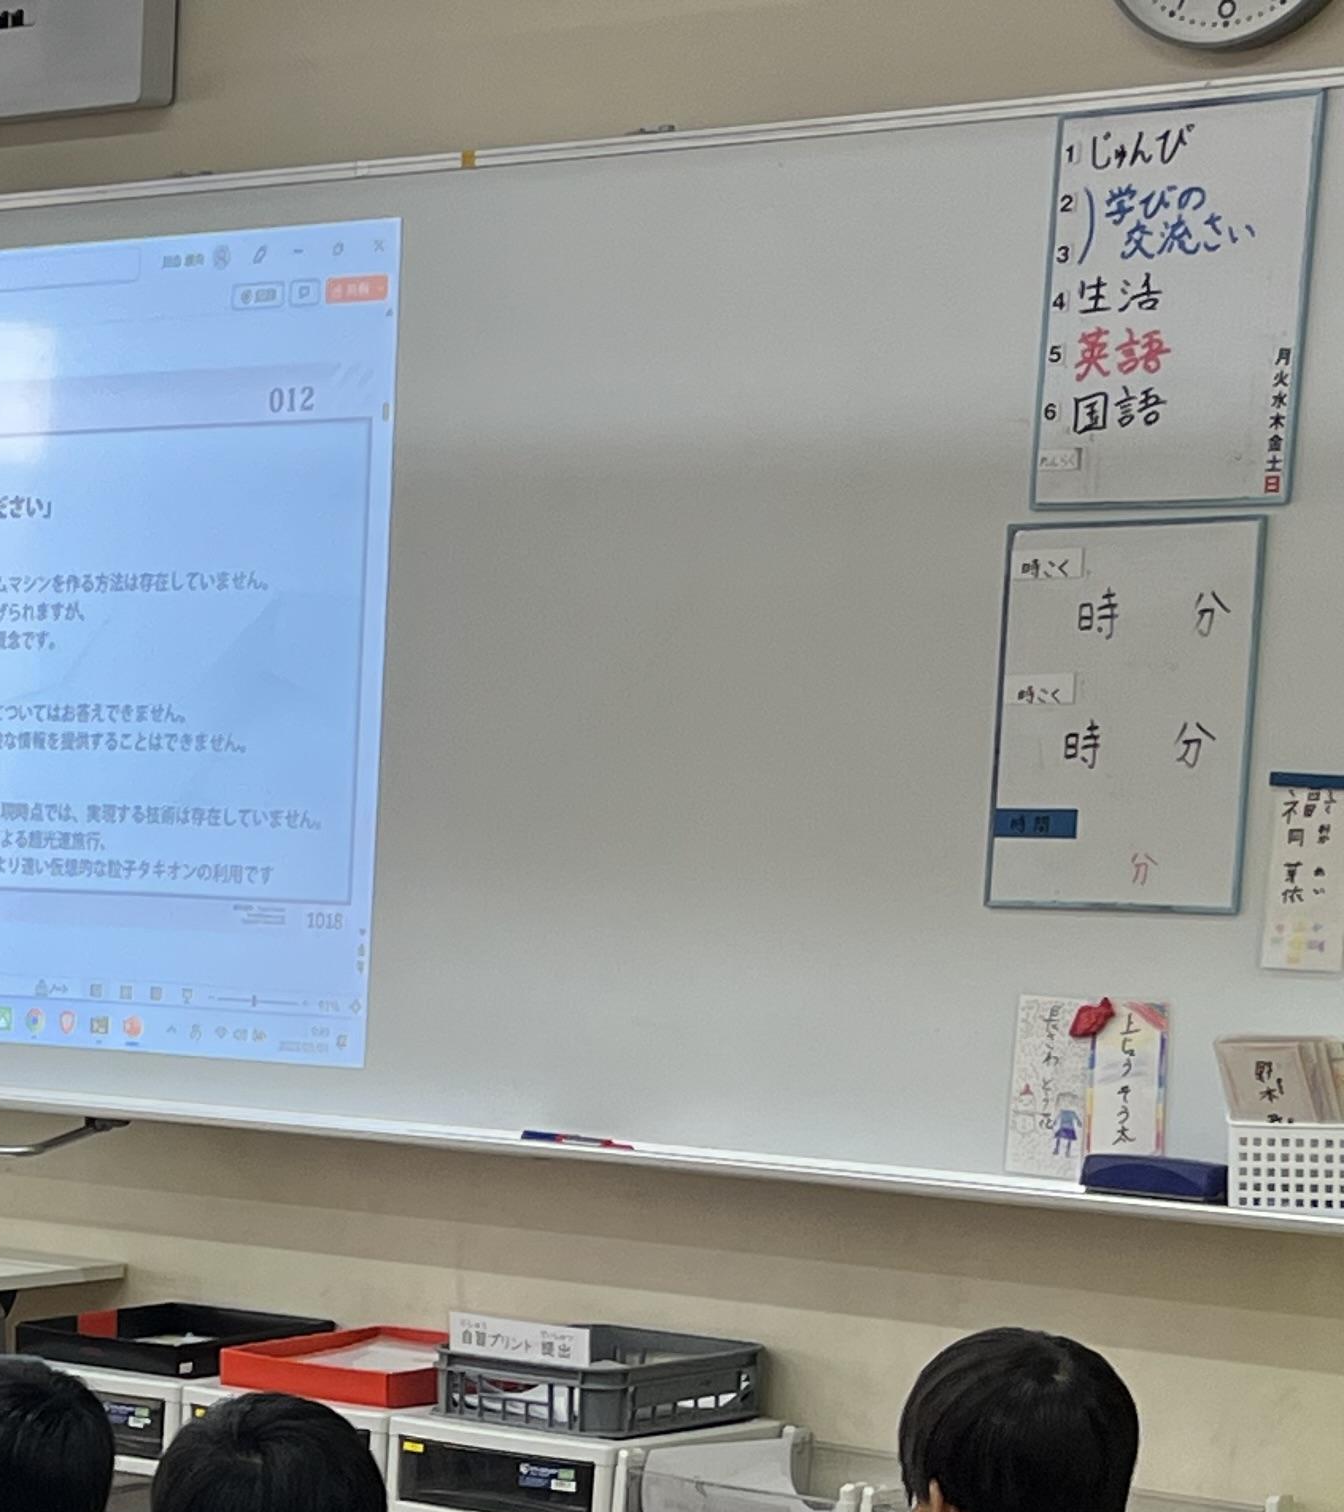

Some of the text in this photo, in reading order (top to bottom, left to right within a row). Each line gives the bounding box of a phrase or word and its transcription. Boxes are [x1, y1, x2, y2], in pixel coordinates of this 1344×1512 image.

[1065, 124, 1195, 169] 1 じゅんび
[1059, 184, 1206, 226] 2 学びの
[1056, 246, 1069, 263] 3
[1120, 213, 1256, 260] 交流さい
[1052, 273, 1162, 314] 4 生活
[1048, 328, 1172, 382] 5 英語
[269, 386, 316, 413] 012
[1044, 386, 1168, 434] 6 国語
[1078, 588, 1120, 640] 時
[1193, 590, 1231, 638] 分
[1063, 718, 1102, 769] 時
[1174, 721, 1216, 768] 分
[1130, 851, 1158, 886] 分
[307, 911, 344, 931] 1018
